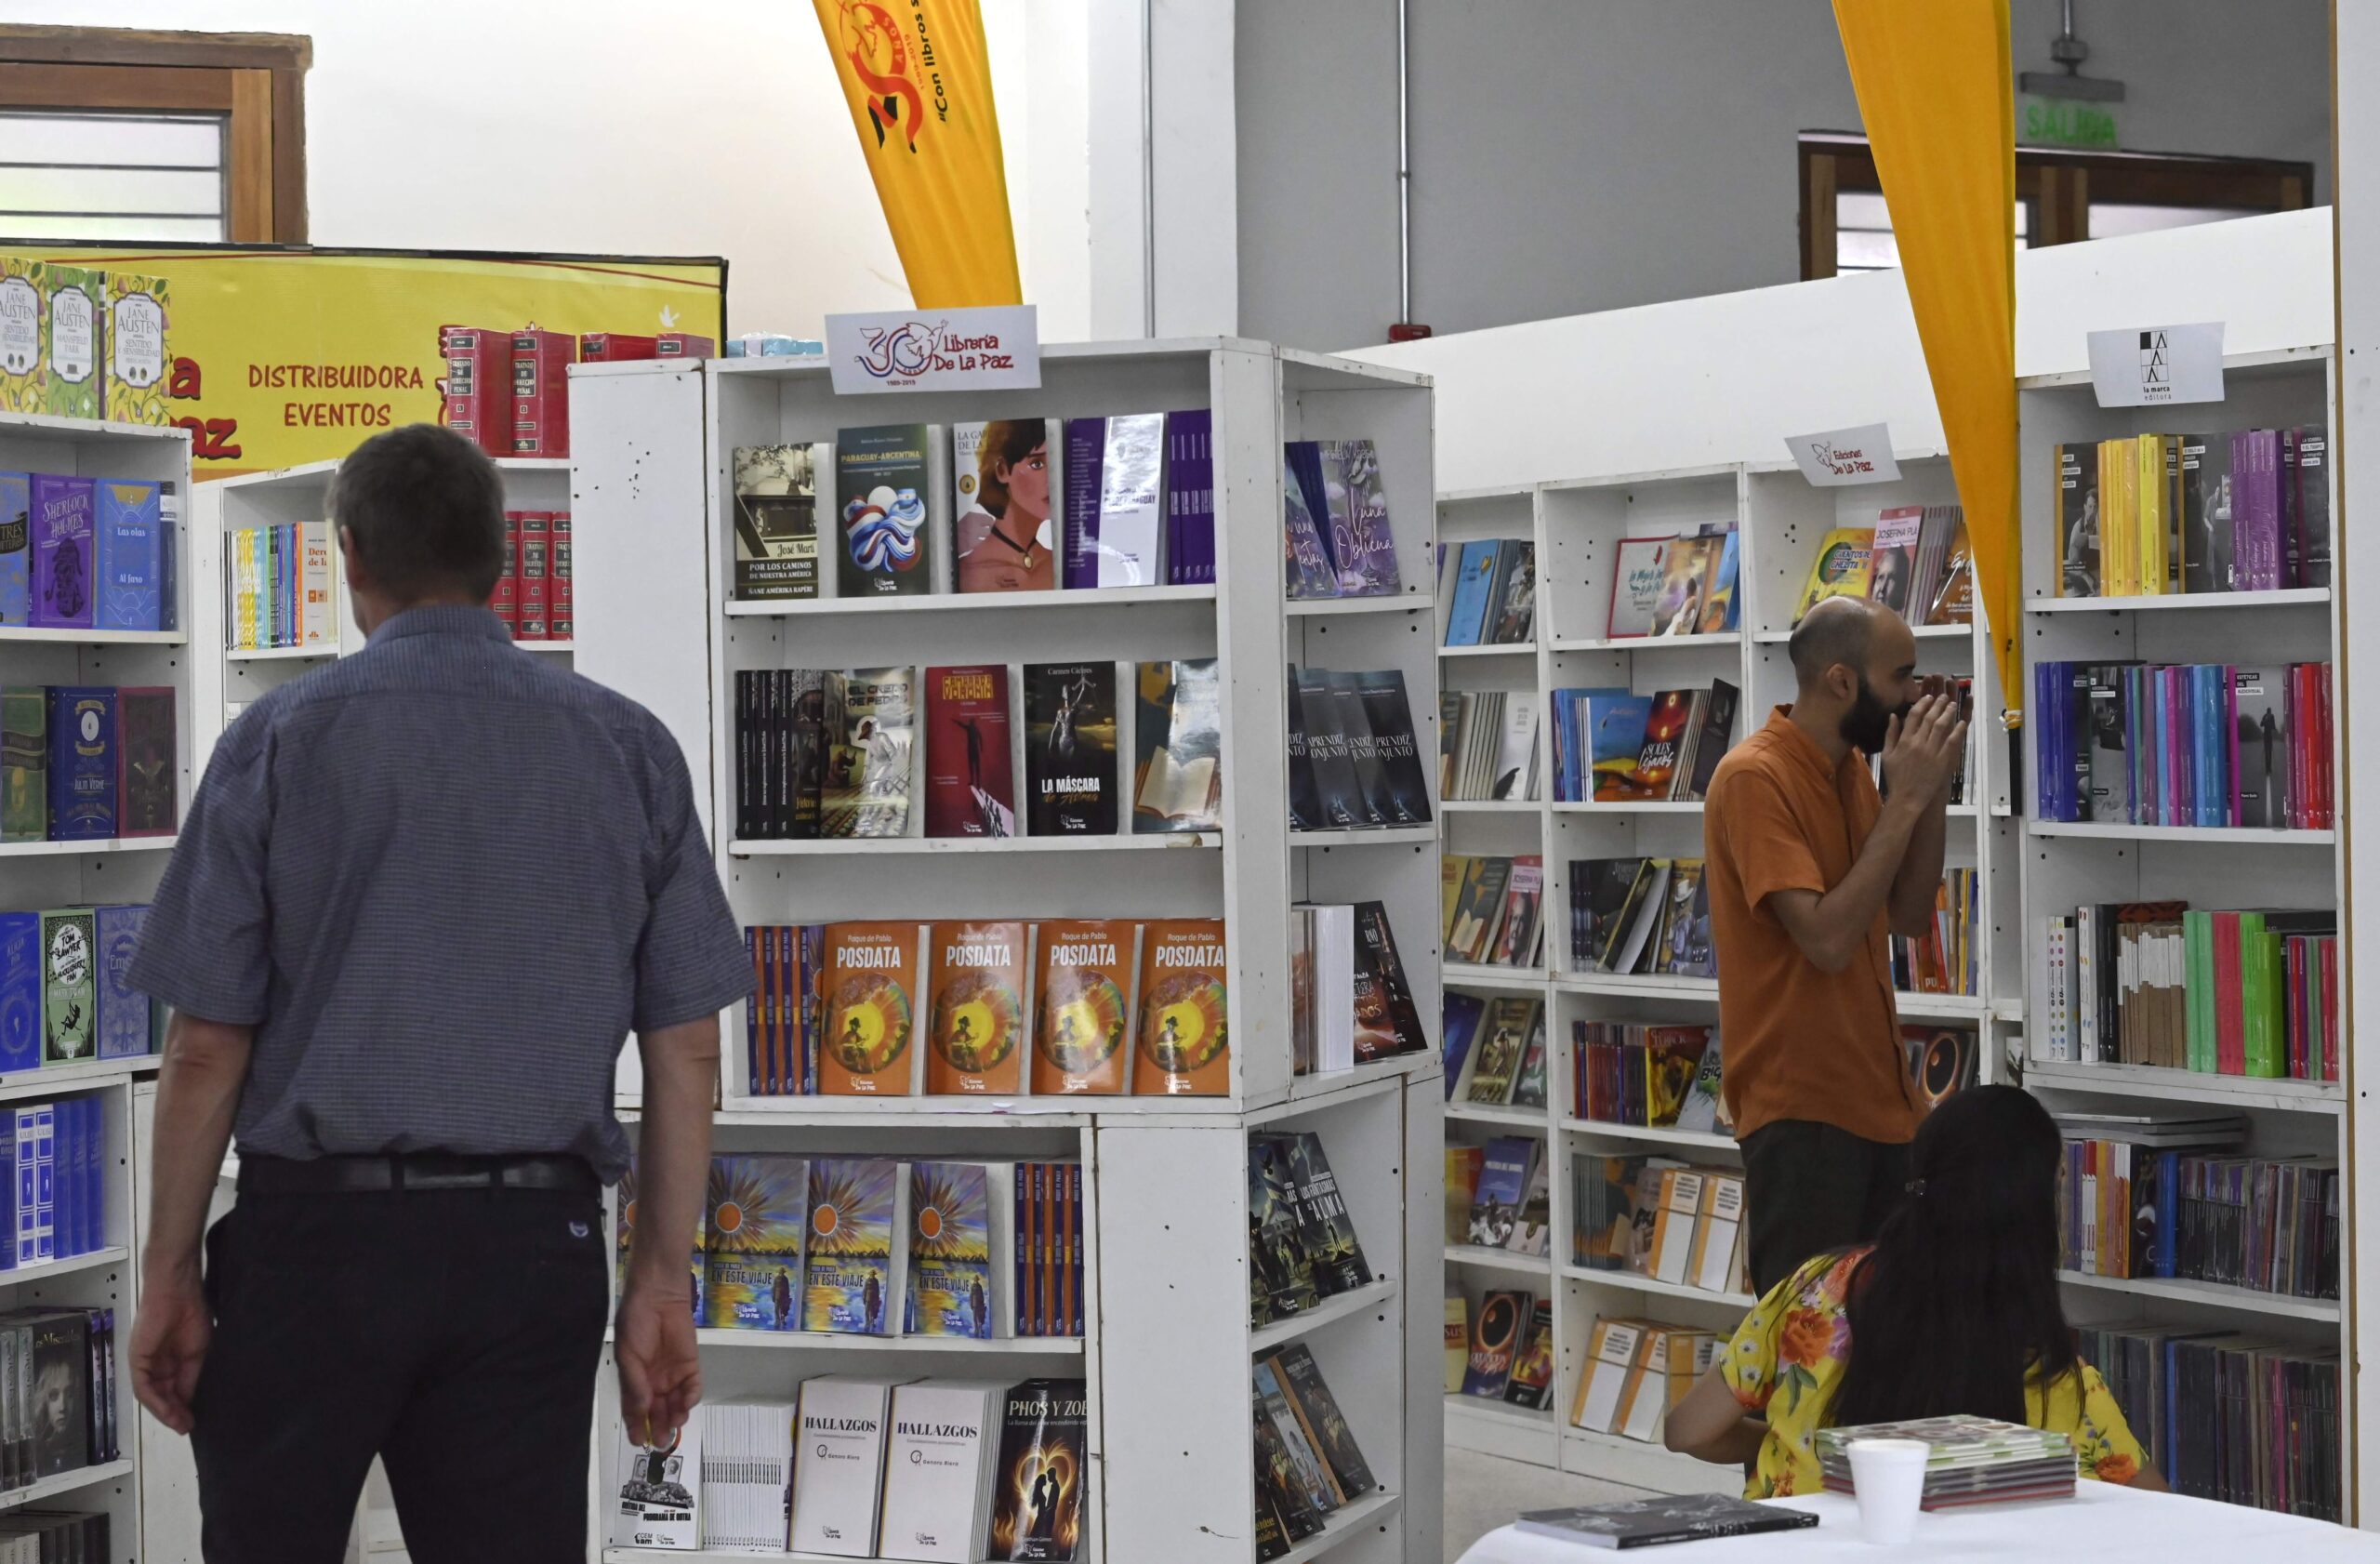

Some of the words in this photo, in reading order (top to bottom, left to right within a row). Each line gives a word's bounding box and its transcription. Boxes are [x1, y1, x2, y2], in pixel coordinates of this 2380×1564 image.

[914, 13, 936, 67] libros
[6, 290, 27, 305] JANE
[63, 299, 82, 314] JANE
[127, 307, 150, 321] JANE
[55, 311, 91, 329] AUSTEN
[117, 316, 160, 334] AUSTEN
[943, 334, 999, 353] Librería
[933, 353, 955, 372] De
[959, 354, 976, 371] La
[979, 352, 1014, 370] Paz
[247, 364, 425, 390] DISTRIBUIDORA
[283, 402, 392, 428] EVENTOS
[958, 431, 969, 441] LA
[958, 441, 972, 450] DE
[1830, 462, 1844, 475] De
[1843, 462, 1855, 474] La
[1853, 461, 1874, 473] Paz
[43, 493, 89, 523] SHERLOCK
[51, 512, 85, 539] HOLMES
[117, 527, 130, 537] Las
[130, 527, 146, 537] olas
[1876, 527, 1906, 540] JOSEFINA
[776, 543, 795, 558] José
[796, 542, 815, 554] Martí
[749, 563, 765, 572] POR
[767, 562, 781, 571] LOS
[782, 561, 813, 570] CAMINOS
[788, 570, 813, 578] AMÉRICA
[119, 574, 127, 584] Al
[848, 684, 865, 696] EL
[848, 696, 865, 707] DE
[1375, 733, 1412, 748] PRENDIZ
[1310, 745, 1348, 762] ONJUNTO
[1041, 779, 1054, 794] LA
[1055, 775, 1101, 794] MÁSCARA
[61, 933, 76, 947] TOM
[866, 934, 874, 943] de
[875, 934, 892, 943] Pablo
[1061, 933, 1081, 943] Roque
[1091, 932, 1107, 940] Pablo
[1167, 933, 1187, 943] Roque
[1197, 933, 1216, 942] Pablo
[56, 941, 82, 961] SAWYER
[837, 946, 902, 968] POSDATA
[945, 945, 1012, 967] POSDATA
[1050, 944, 1117, 967] POSDATA
[1155, 945, 1225, 968] POSDATA
[1312, 1193, 1346, 1222] ALMA
[711, 1270, 723, 1283] EN
[725, 1270, 746, 1284] ESTE
[747, 1271, 774, 1285] VIAJE
[809, 1272, 820, 1286] EN
[822, 1273, 840, 1287] ESTE
[841, 1274, 865, 1288] VIAJE
[919, 1276, 930, 1289] EN
[931, 1277, 949, 1291] ESTE
[949, 1278, 970, 1292] VIAJE
[1008, 1399, 1049, 1417] PHOS
[1052, 1400, 1062, 1416] Y
[804, 1416, 878, 1434] HALLAZGOS
[897, 1421, 978, 1438] HALLAZGOS
